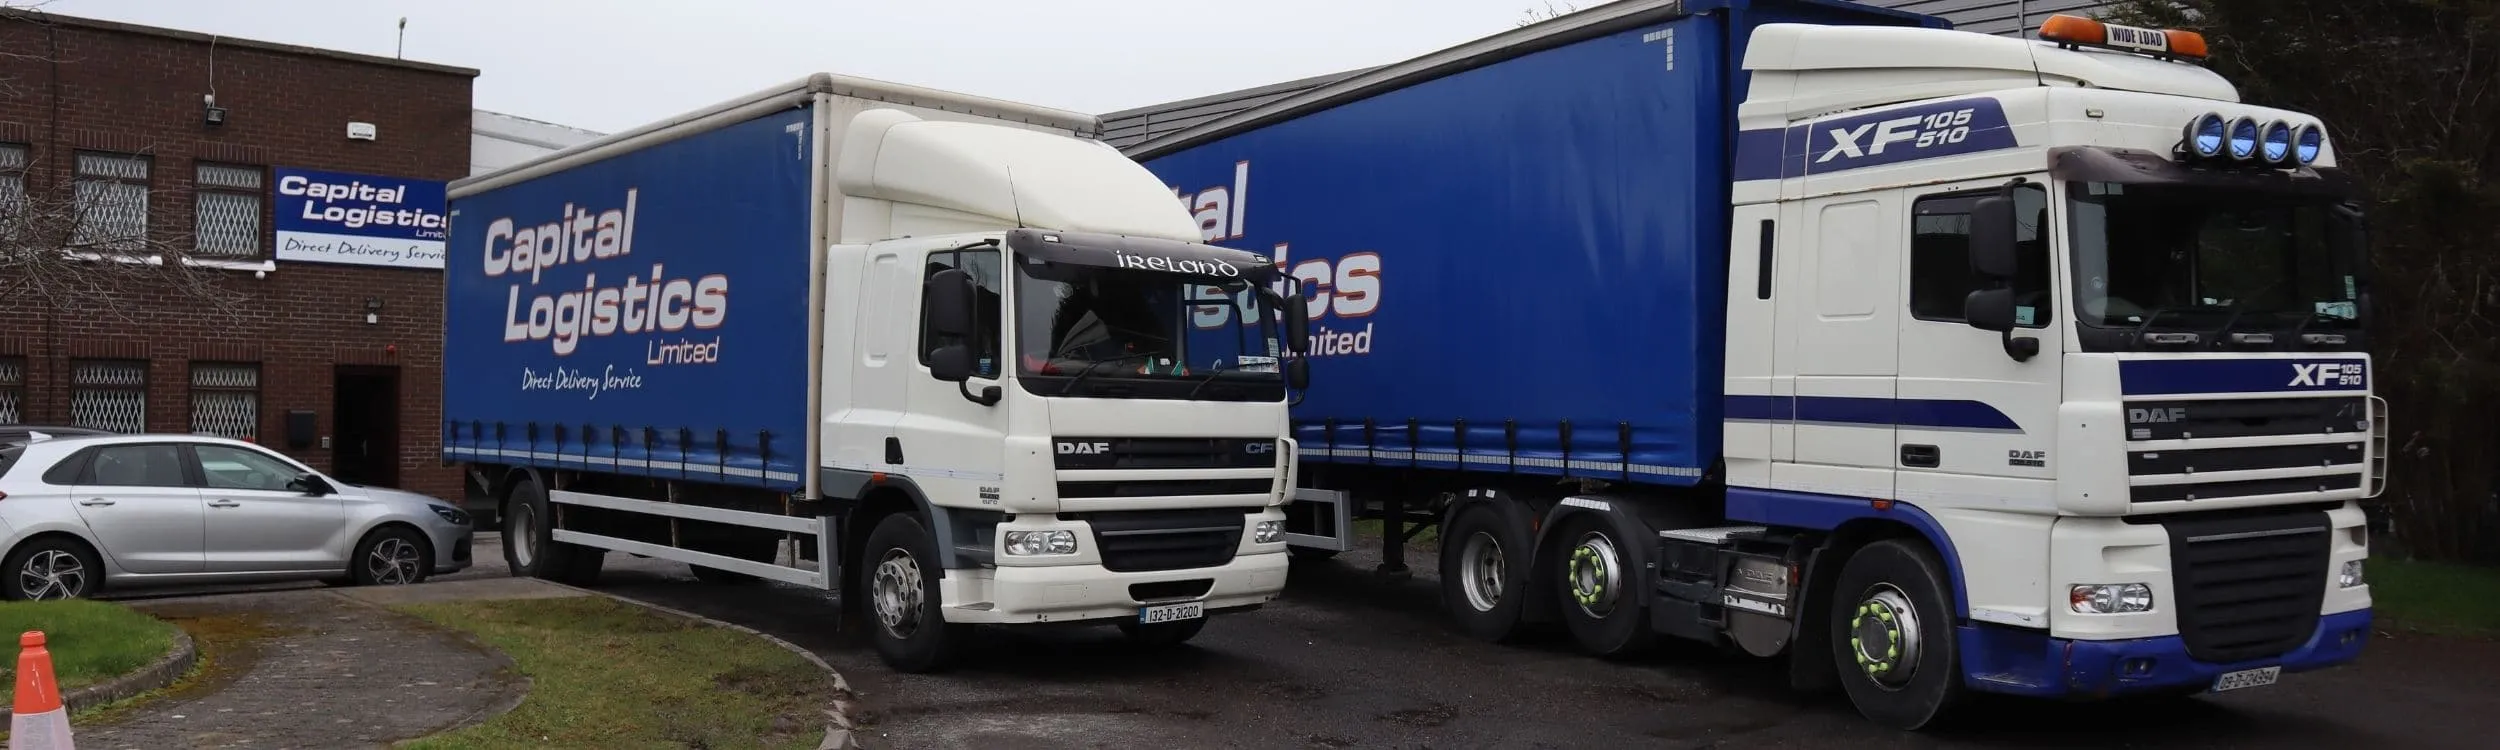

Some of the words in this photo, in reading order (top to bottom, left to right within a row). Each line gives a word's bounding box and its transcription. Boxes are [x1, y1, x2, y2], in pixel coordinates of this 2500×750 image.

[2111, 27, 2136, 43] WIDE
[2138, 30, 2162, 46] LOAD
[1815, 115, 1922, 163] XF
[1923, 108, 1975, 130] 105
[1915, 126, 1970, 148] 510
[279, 175, 405, 203] Capital
[483, 187, 638, 285] Capital
[285, 237, 331, 252] Direct
[338, 241, 400, 262] Delivery
[406, 246, 445, 260] Servic
[504, 263, 728, 356] Logistics
[647, 336, 720, 365] Limited
[522, 367, 552, 391] Direct
[555, 366, 599, 400] Delivery
[602, 364, 642, 391] Service
[2287, 363, 2340, 387] XF
[2340, 364, 2362, 375] 105
[2339, 375, 2362, 385] 510
[2129, 408, 2186, 423] DAF
[1057, 442, 1110, 454] DAF
[1246, 443, 1274, 454] CF
[2009, 449, 2045, 459] DAF
